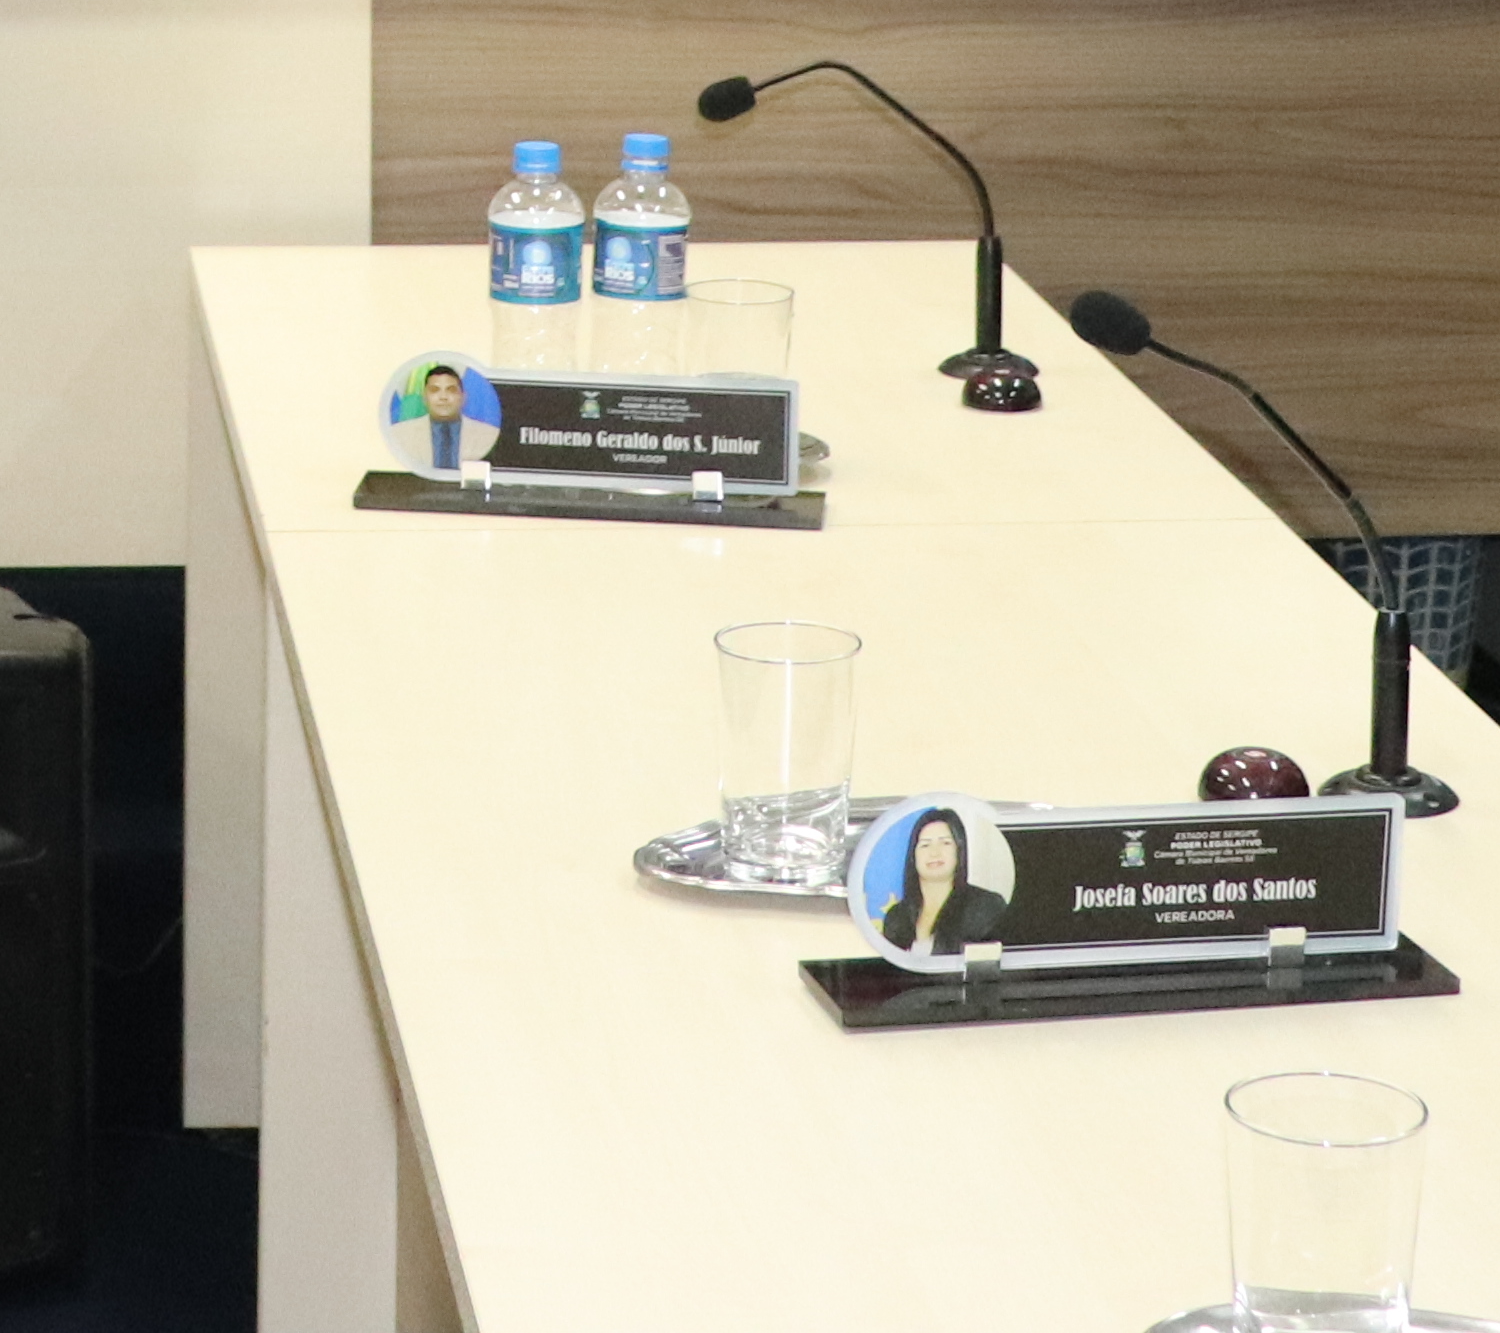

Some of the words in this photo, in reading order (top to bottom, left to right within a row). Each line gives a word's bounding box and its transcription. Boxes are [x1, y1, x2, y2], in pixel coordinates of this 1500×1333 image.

[519, 426, 593, 447] Filomeno
[595, 430, 659, 451] Geraldo
[662, 432, 690, 452] dos
[693, 435, 708, 452] S.
[710, 434, 762, 455] Júnior
[1072, 883, 1136, 912] Josefa
[1142, 881, 1207, 906] Soares
[1212, 879, 1248, 902] dos
[1253, 877, 1317, 902] Santos
[1154, 908, 1235, 924] VEREADORA
